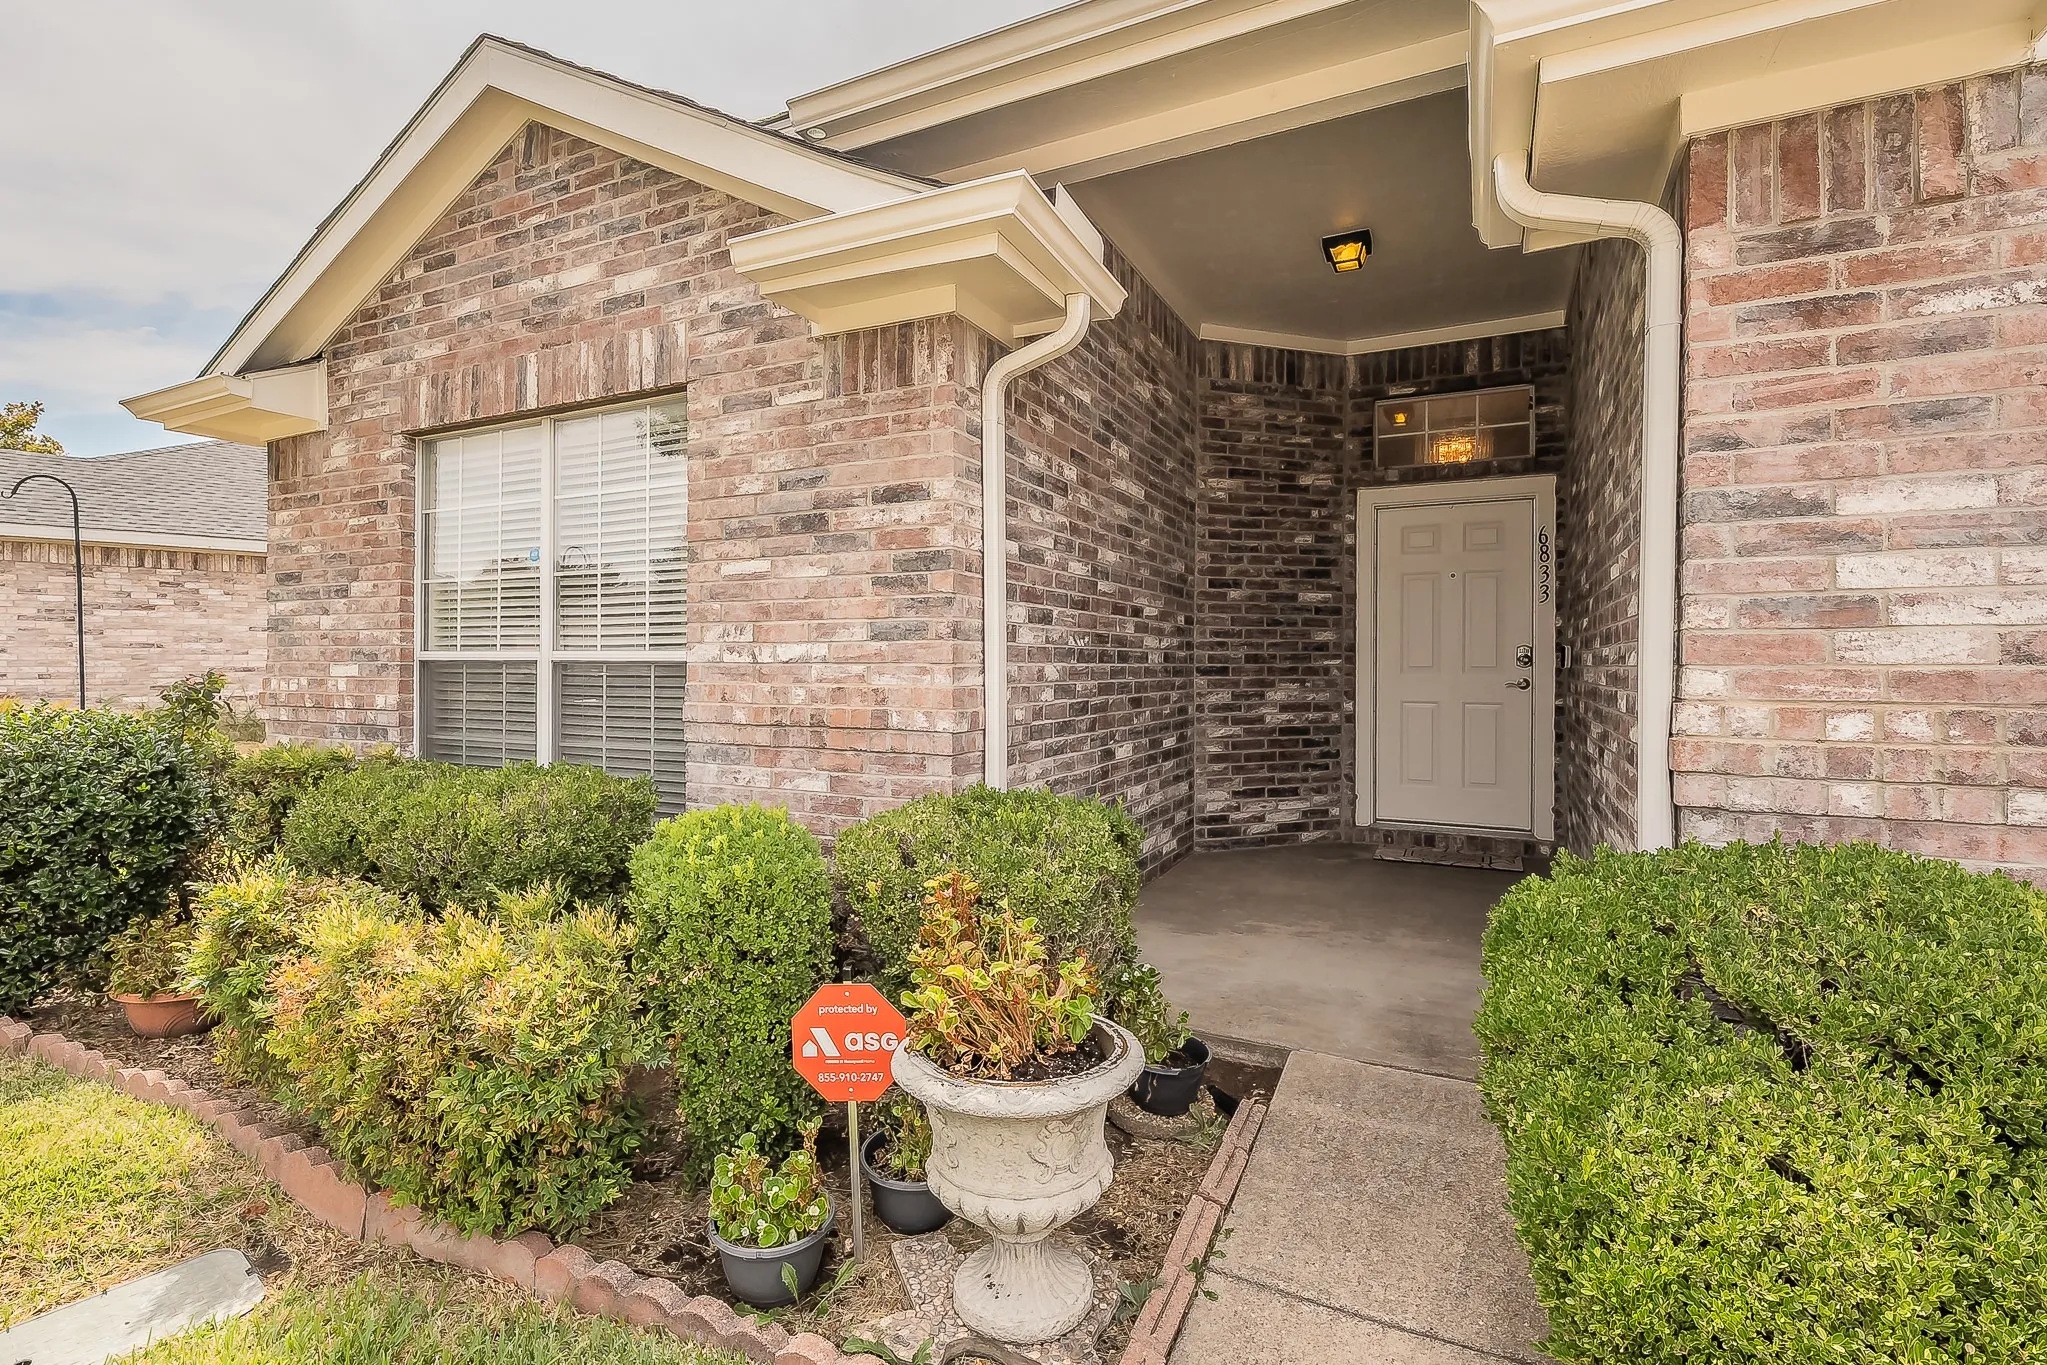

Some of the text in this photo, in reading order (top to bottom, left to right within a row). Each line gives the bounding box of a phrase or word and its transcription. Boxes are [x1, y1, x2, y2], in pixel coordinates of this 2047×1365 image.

[1538, 525, 1550, 604] 6833
[818, 1004, 878, 1016] protected by
[818, 1072, 884, 1082] 855-910-2747
